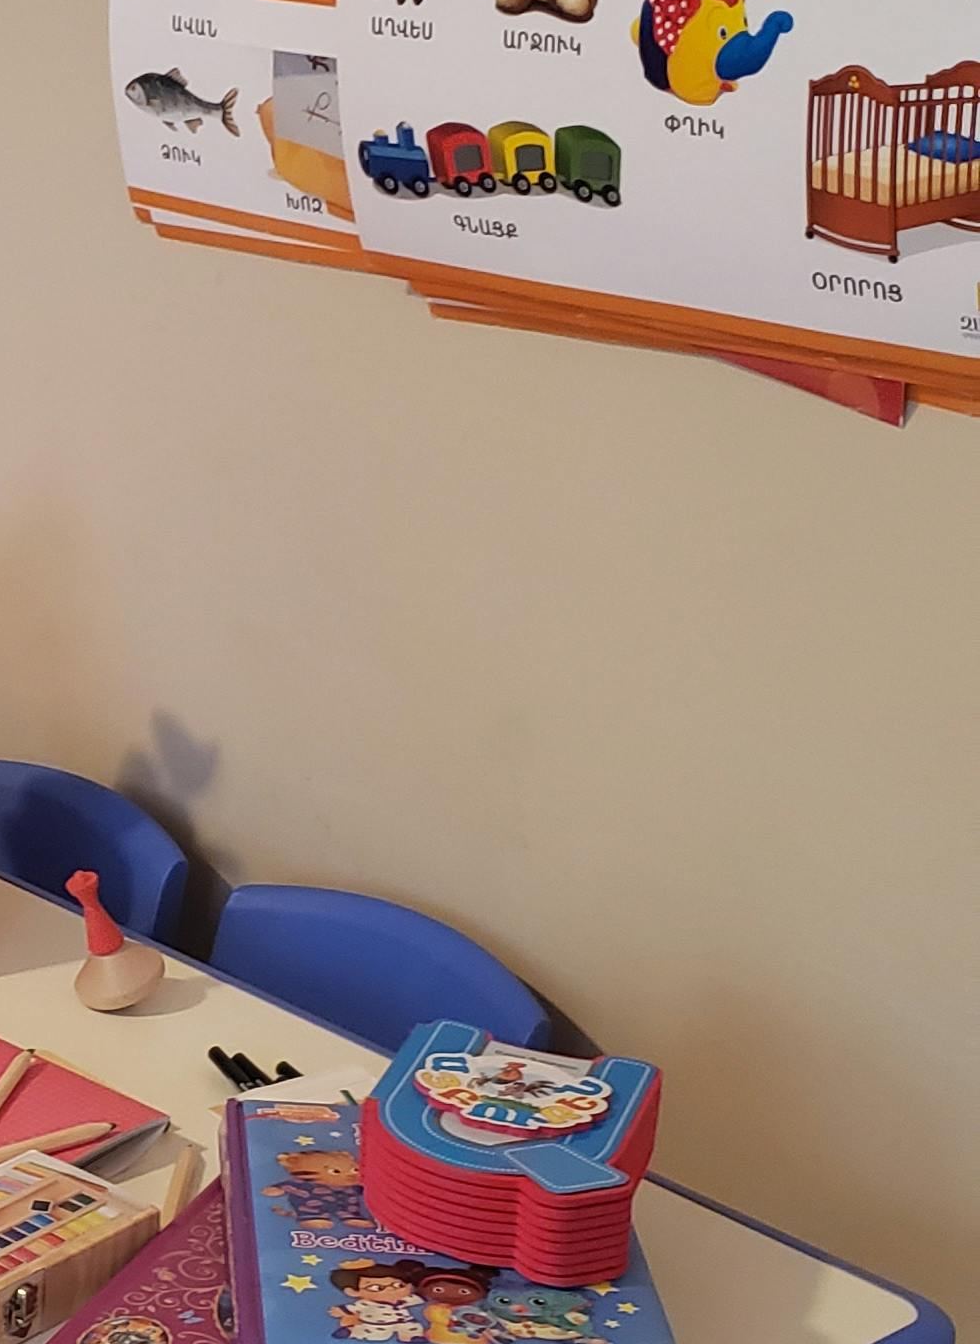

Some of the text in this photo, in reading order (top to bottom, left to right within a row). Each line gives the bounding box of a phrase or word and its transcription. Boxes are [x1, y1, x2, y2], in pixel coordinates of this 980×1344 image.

[371, 16, 433, 41] ԱՂՎԵՍ
[504, 29, 582, 56] ԱՐՋՈՒԿ
[664, 114, 725, 139] ՓՂԻԿ
[160, 144, 202, 166] ՁՈՒԿ
[286, 193, 323, 214] ԽՈԶ
[453, 214, 519, 239] ԳՆԱՑՔ
[812, 272, 903, 302] ՕՐՈՐՈՑ
